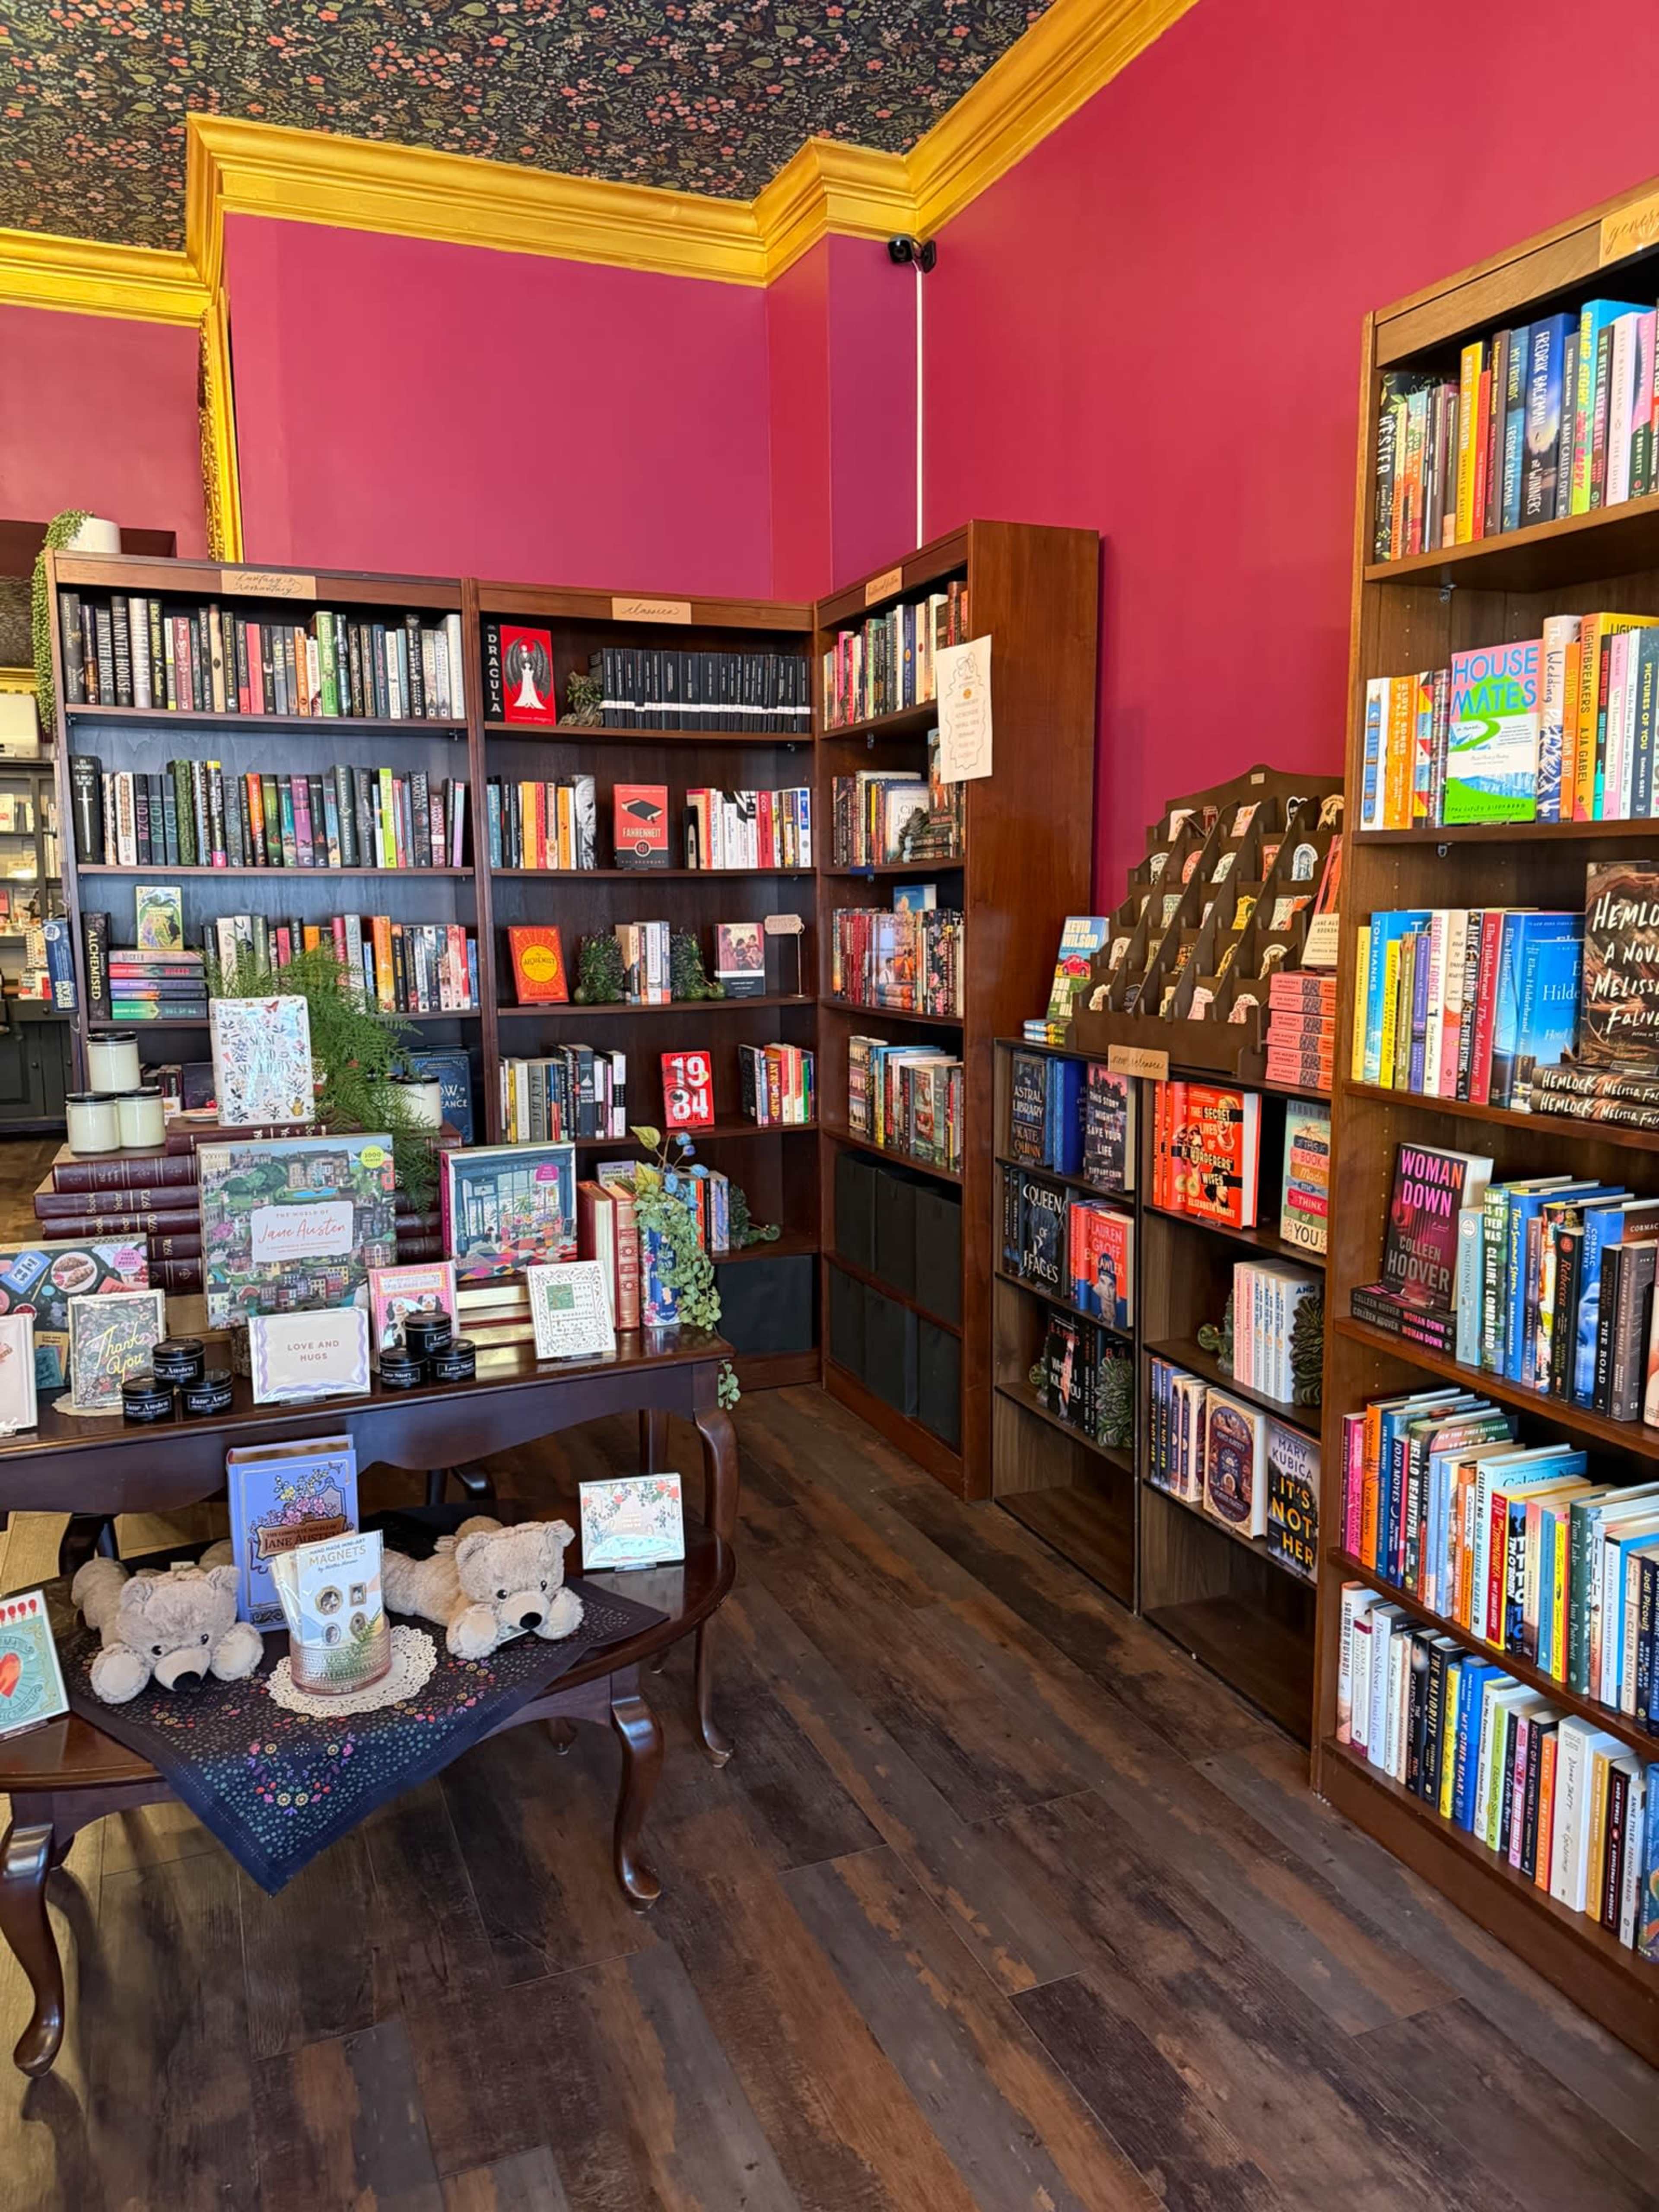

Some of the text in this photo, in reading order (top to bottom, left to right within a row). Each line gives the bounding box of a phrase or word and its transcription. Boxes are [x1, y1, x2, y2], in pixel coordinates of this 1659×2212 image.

[1578, 311, 1592, 406] SWAMP STORY
[1598, 335, 1608, 353] WE
[1508, 347, 1520, 400] MY FRIENDS
[1531, 331, 1550, 426] FREDRIK BACKMAN
[1596, 355, 1607, 385] WERE
[1461, 355, 1474, 450] KATE ATKINSON
[1594, 388, 1605, 420] NEVER
[1376, 415, 1395, 476] HESTER
[1562, 423, 1571, 443] MAN
[1503, 426, 1517, 505] FREDRIK BACKMAN
[1560, 445, 1570, 478] CALLED
[1558, 481, 1568, 499] OVE
[99, 627, 112, 691] NINTH HOUSE
[114, 622, 130, 693] NINTH HOUSE
[135, 658, 149, 690] BENT
[487, 634, 501, 713] DRACULA
[1452, 646, 1538, 686] HOUSE
[1542, 626, 1563, 703] The Wedding
[1580, 623, 1595, 714] LIGHTBREAKERS
[1451, 679, 1538, 715] MATES
[1640, 662, 1653, 750] PICTURES OF YOU
[1562, 730, 1574, 778] LAWN BOY
[1577, 727, 1591, 785] AJA GABEL
[1431, 916, 1442, 954] BEFORE
[1468, 925, 1480, 945] ALIX
[1604, 942, 1615, 963] A
[88, 930, 101, 1000] ALCHEMISED
[1370, 920, 1381, 991] TOM HANKS
[1481, 923, 1495, 1000] Elin Hilderbrand
[1500, 928, 1514, 1004] Elin Hilderbrand
[1430, 965, 1440, 1002] FORGET
[1464, 961, 1477, 1002] HARROW
[1521, 957, 1536, 1033] Elin Hilderbrand
[1458, 1010, 1472, 1072] THE EVERLASTING
[1471, 1005, 1487, 1077] The Academy
[671, 1057, 708, 1087] 19
[1541, 1071, 1596, 1090] HEMLOCK
[532, 1075, 542, 1123] ULYSSES
[1013, 1100, 1044, 1116] LIBRARY
[1014, 1086, 1042, 1103] ASTRAL
[1103, 1098, 1119, 1108] STORY
[1539, 1094, 1597, 1113] HEMLOCK
[1087, 1125, 1122, 1141] SAVE YOUR
[1203, 1108, 1230, 1121] SECRET
[1014, 1141, 1041, 1158] QUINN
[1017, 1127, 1037, 1141] KATE
[1097, 1145, 1112, 1157] LIFE
[1300, 1152, 1323, 1167] BOOK
[1400, 1149, 1464, 1190] WOMAN
[1201, 1173, 1224, 1185] WIVES
[1401, 1179, 1453, 1217] DOWN
[86, 1193, 97, 1214] Book
[113, 1193, 123, 1211] Year
[140, 1190, 150, 1209] 1973
[1029, 1185, 1062, 1213] QUEEN
[1298, 1194, 1323, 1210] THINK
[148, 1214, 157, 1233] 1970
[258, 1217, 346, 1244] Jane Austen
[1293, 1222, 1319, 1246] YOU
[163, 1239, 172, 1255] 1974
[1398, 1236, 1441, 1262] COLLEEN
[1510, 1207, 1522, 1296] These Summer Storms
[1582, 1222, 1591, 1269] McCARTHY
[1589, 1227, 1598, 1267] CORMAC
[1028, 1254, 1058, 1284] FACES
[1386, 1249, 1452, 1292] HOOVER
[1463, 1243, 1472, 1293] PACHINKO
[1558, 1260, 1572, 1307] Rebecca
[1484, 1246, 1497, 1349] CLAIRE LOMBARDO
[84, 1323, 144, 1370] Thank
[287, 1340, 339, 1351] LOVE AND
[300, 1353, 328, 1362] HUGS
[1598, 1320, 1608, 1384] THE ROAD
[1272, 1449, 1314, 1482] KUBICA
[1278, 1437, 1307, 1459] MARY
[1392, 1441, 1402, 1503] JOJO MOYES
[1407, 1439, 1421, 1539] HELLO BEAUTIFUL
[1477, 1471, 1485, 1504] CELESTE
[1280, 1477, 1311, 1510] IT'S
[1477, 1506, 1484, 1519] NG
[1272, 1497, 1313, 1539] NOT
[264, 1537, 292, 1550] JANE
[309, 1545, 366, 1565] MAGNETS
[1282, 1532, 1314, 1567] HER
[1474, 1541, 1482, 1576] MISSING
[1570, 1519, 1582, 1566] Tom Lake
[1506, 1535, 1518, 1598] TIM O'BRIEN
[1640, 1569, 1652, 1631] Jodi Picoult
[1342, 1601, 1352, 1677] SALMAN RUSHDIE
[1569, 1599, 1580, 1660] Ann Patchett
[1373, 1621, 1383, 1692] Thomas Schlesser
[1625, 1621, 1636, 1694] CLUB DUMAS
[1427, 1652, 1441, 1737] THE MAJORITY
[1456, 1713, 1469, 1796] MY OTHER HEART
[1627, 1818, 1636, 1843] TYLER
